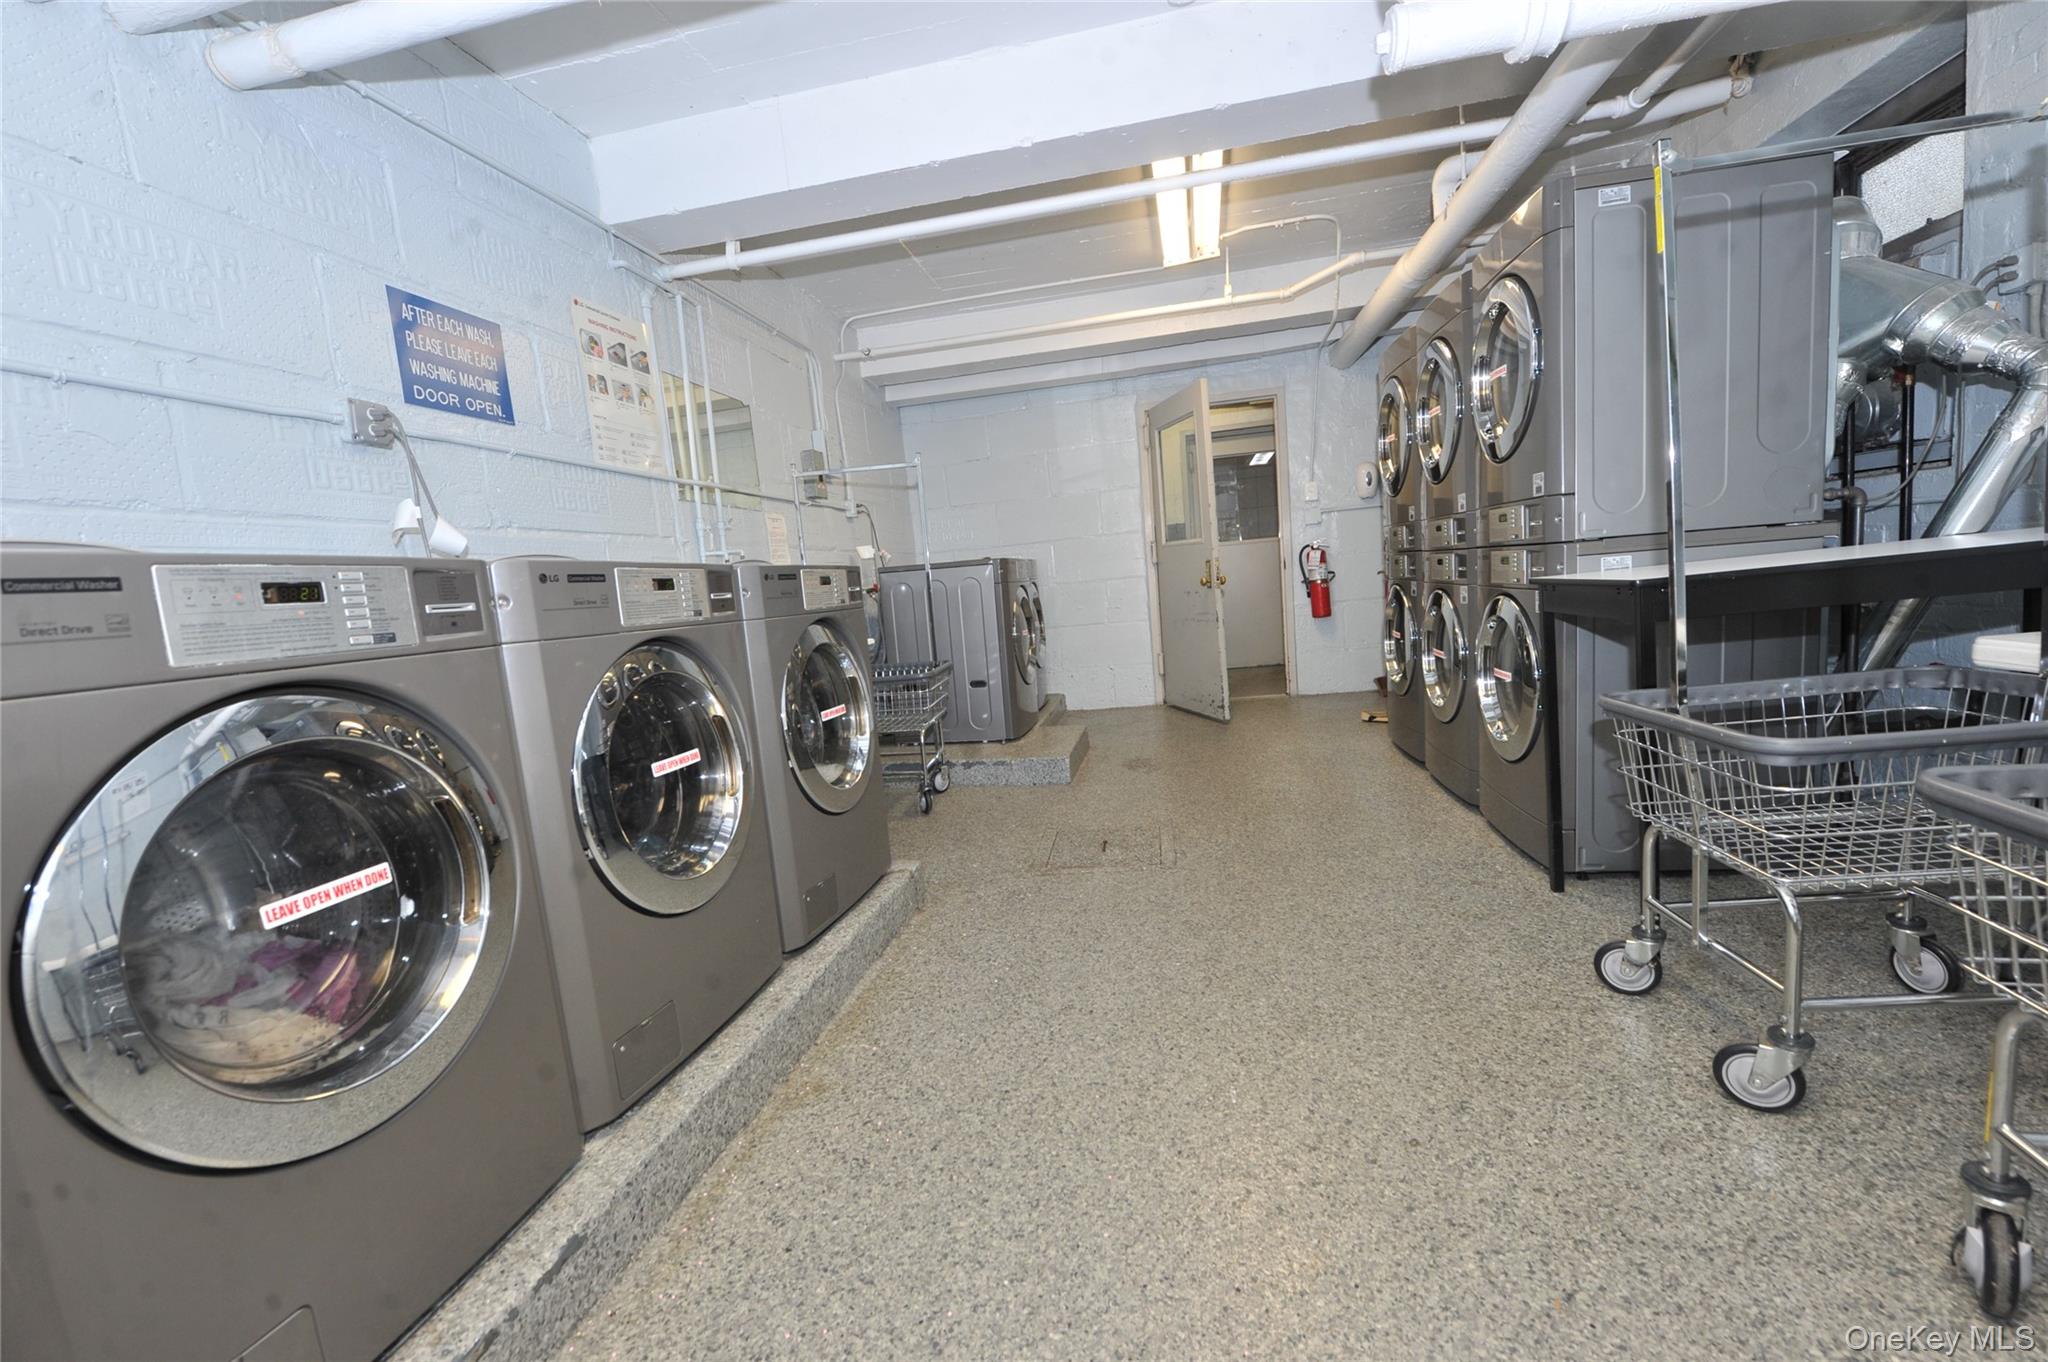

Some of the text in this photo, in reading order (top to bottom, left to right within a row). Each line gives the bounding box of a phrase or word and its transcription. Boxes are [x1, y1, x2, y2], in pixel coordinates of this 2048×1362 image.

[401, 302, 495, 348] AFTER EACH WASH.
[405, 330, 498, 372] PLEASE LEAVE EACH
[408, 358, 501, 396] WASHING MACHINE
[413, 385, 506, 418] DOOR OPEN.
[3, 580, 119, 592] Commercial Washer
[300, 587, 318, 601] 21
[19, 626, 58, 638] Direct
[61, 624, 93, 635] Drive
[265, 867, 390, 924] LEAVE OPEN WHEN DONE
